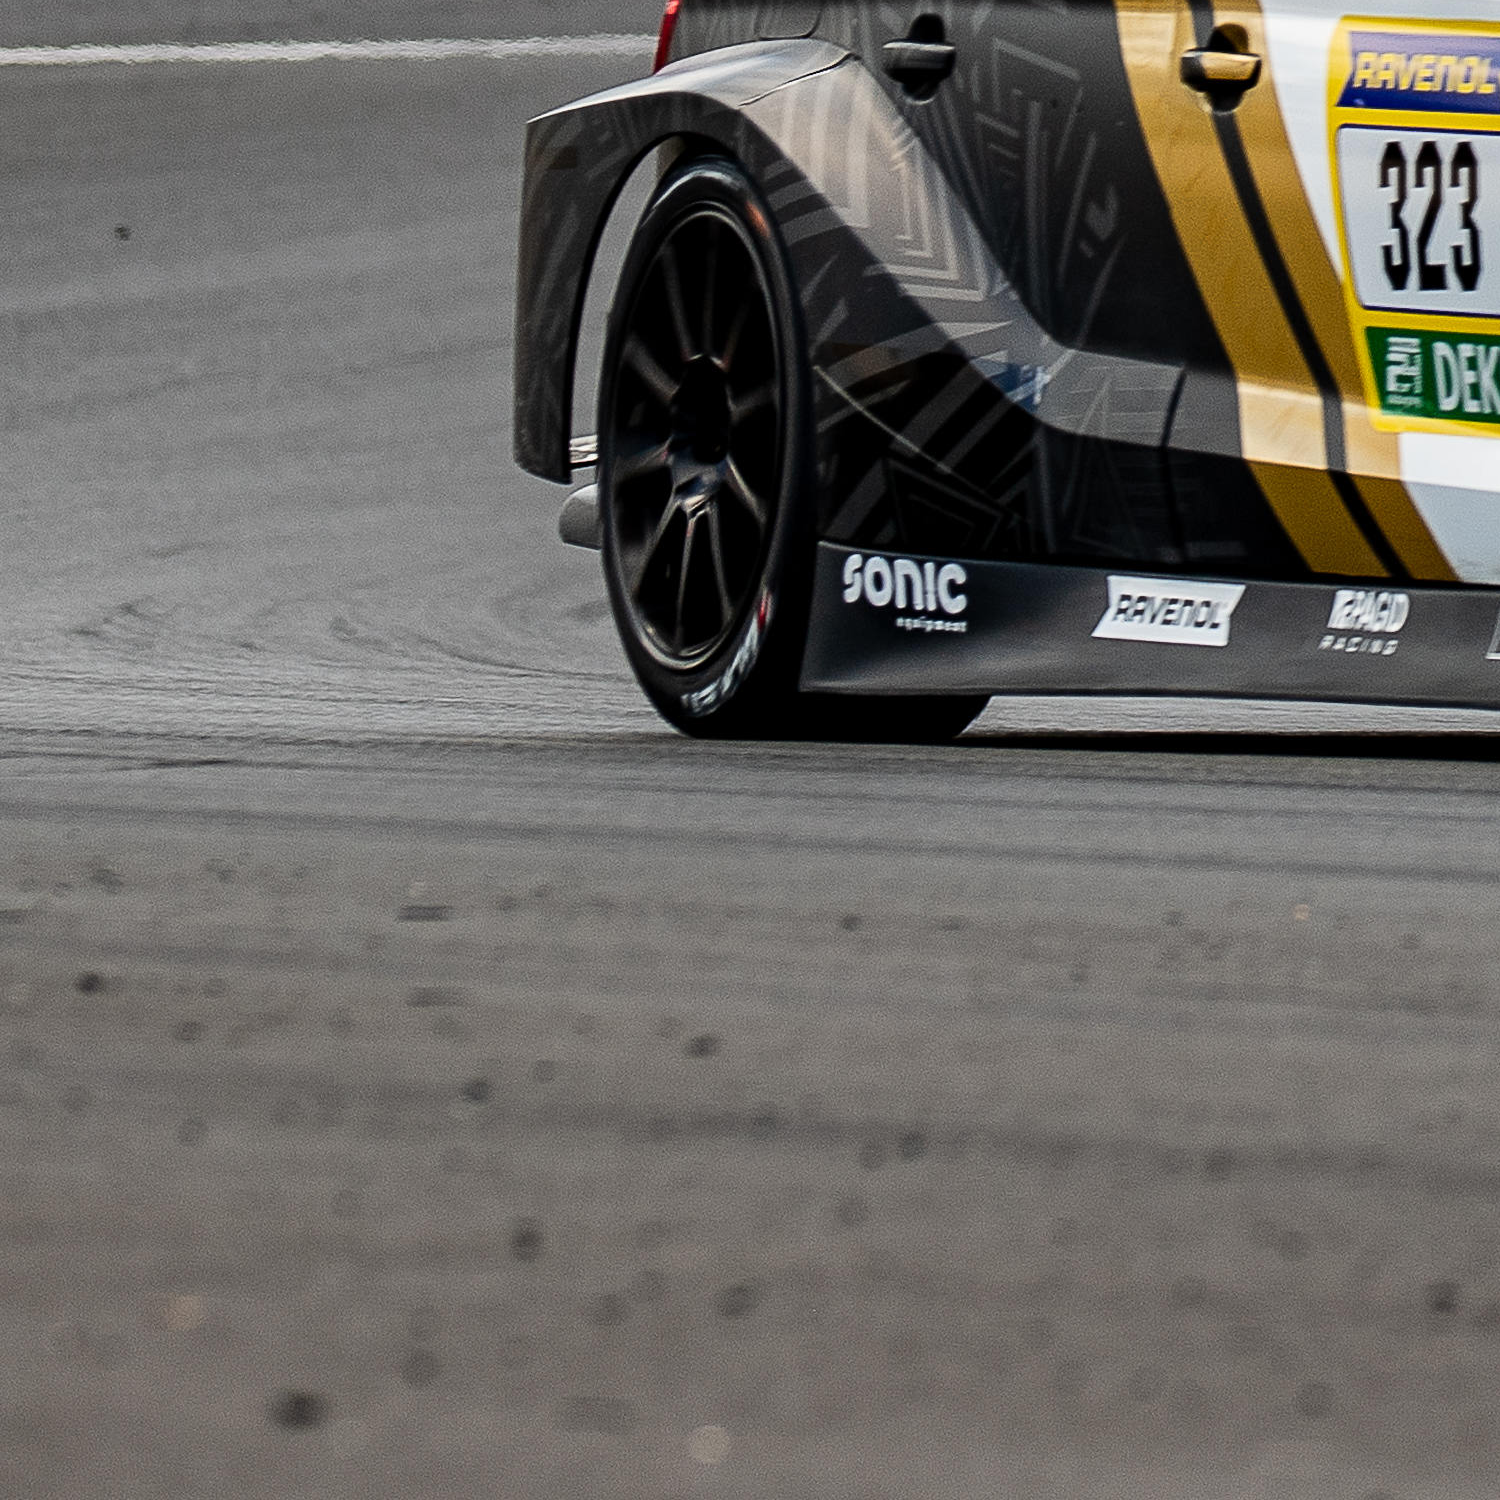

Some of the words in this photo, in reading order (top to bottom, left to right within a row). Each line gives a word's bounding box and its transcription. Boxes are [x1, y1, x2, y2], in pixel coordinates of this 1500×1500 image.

[1351, 51, 1499, 95] RAVENOL
[1378, 140, 1482, 292] 323
[1112, 593, 1223, 630] RAVENOL
[1317, 634, 1400, 657] RACING
